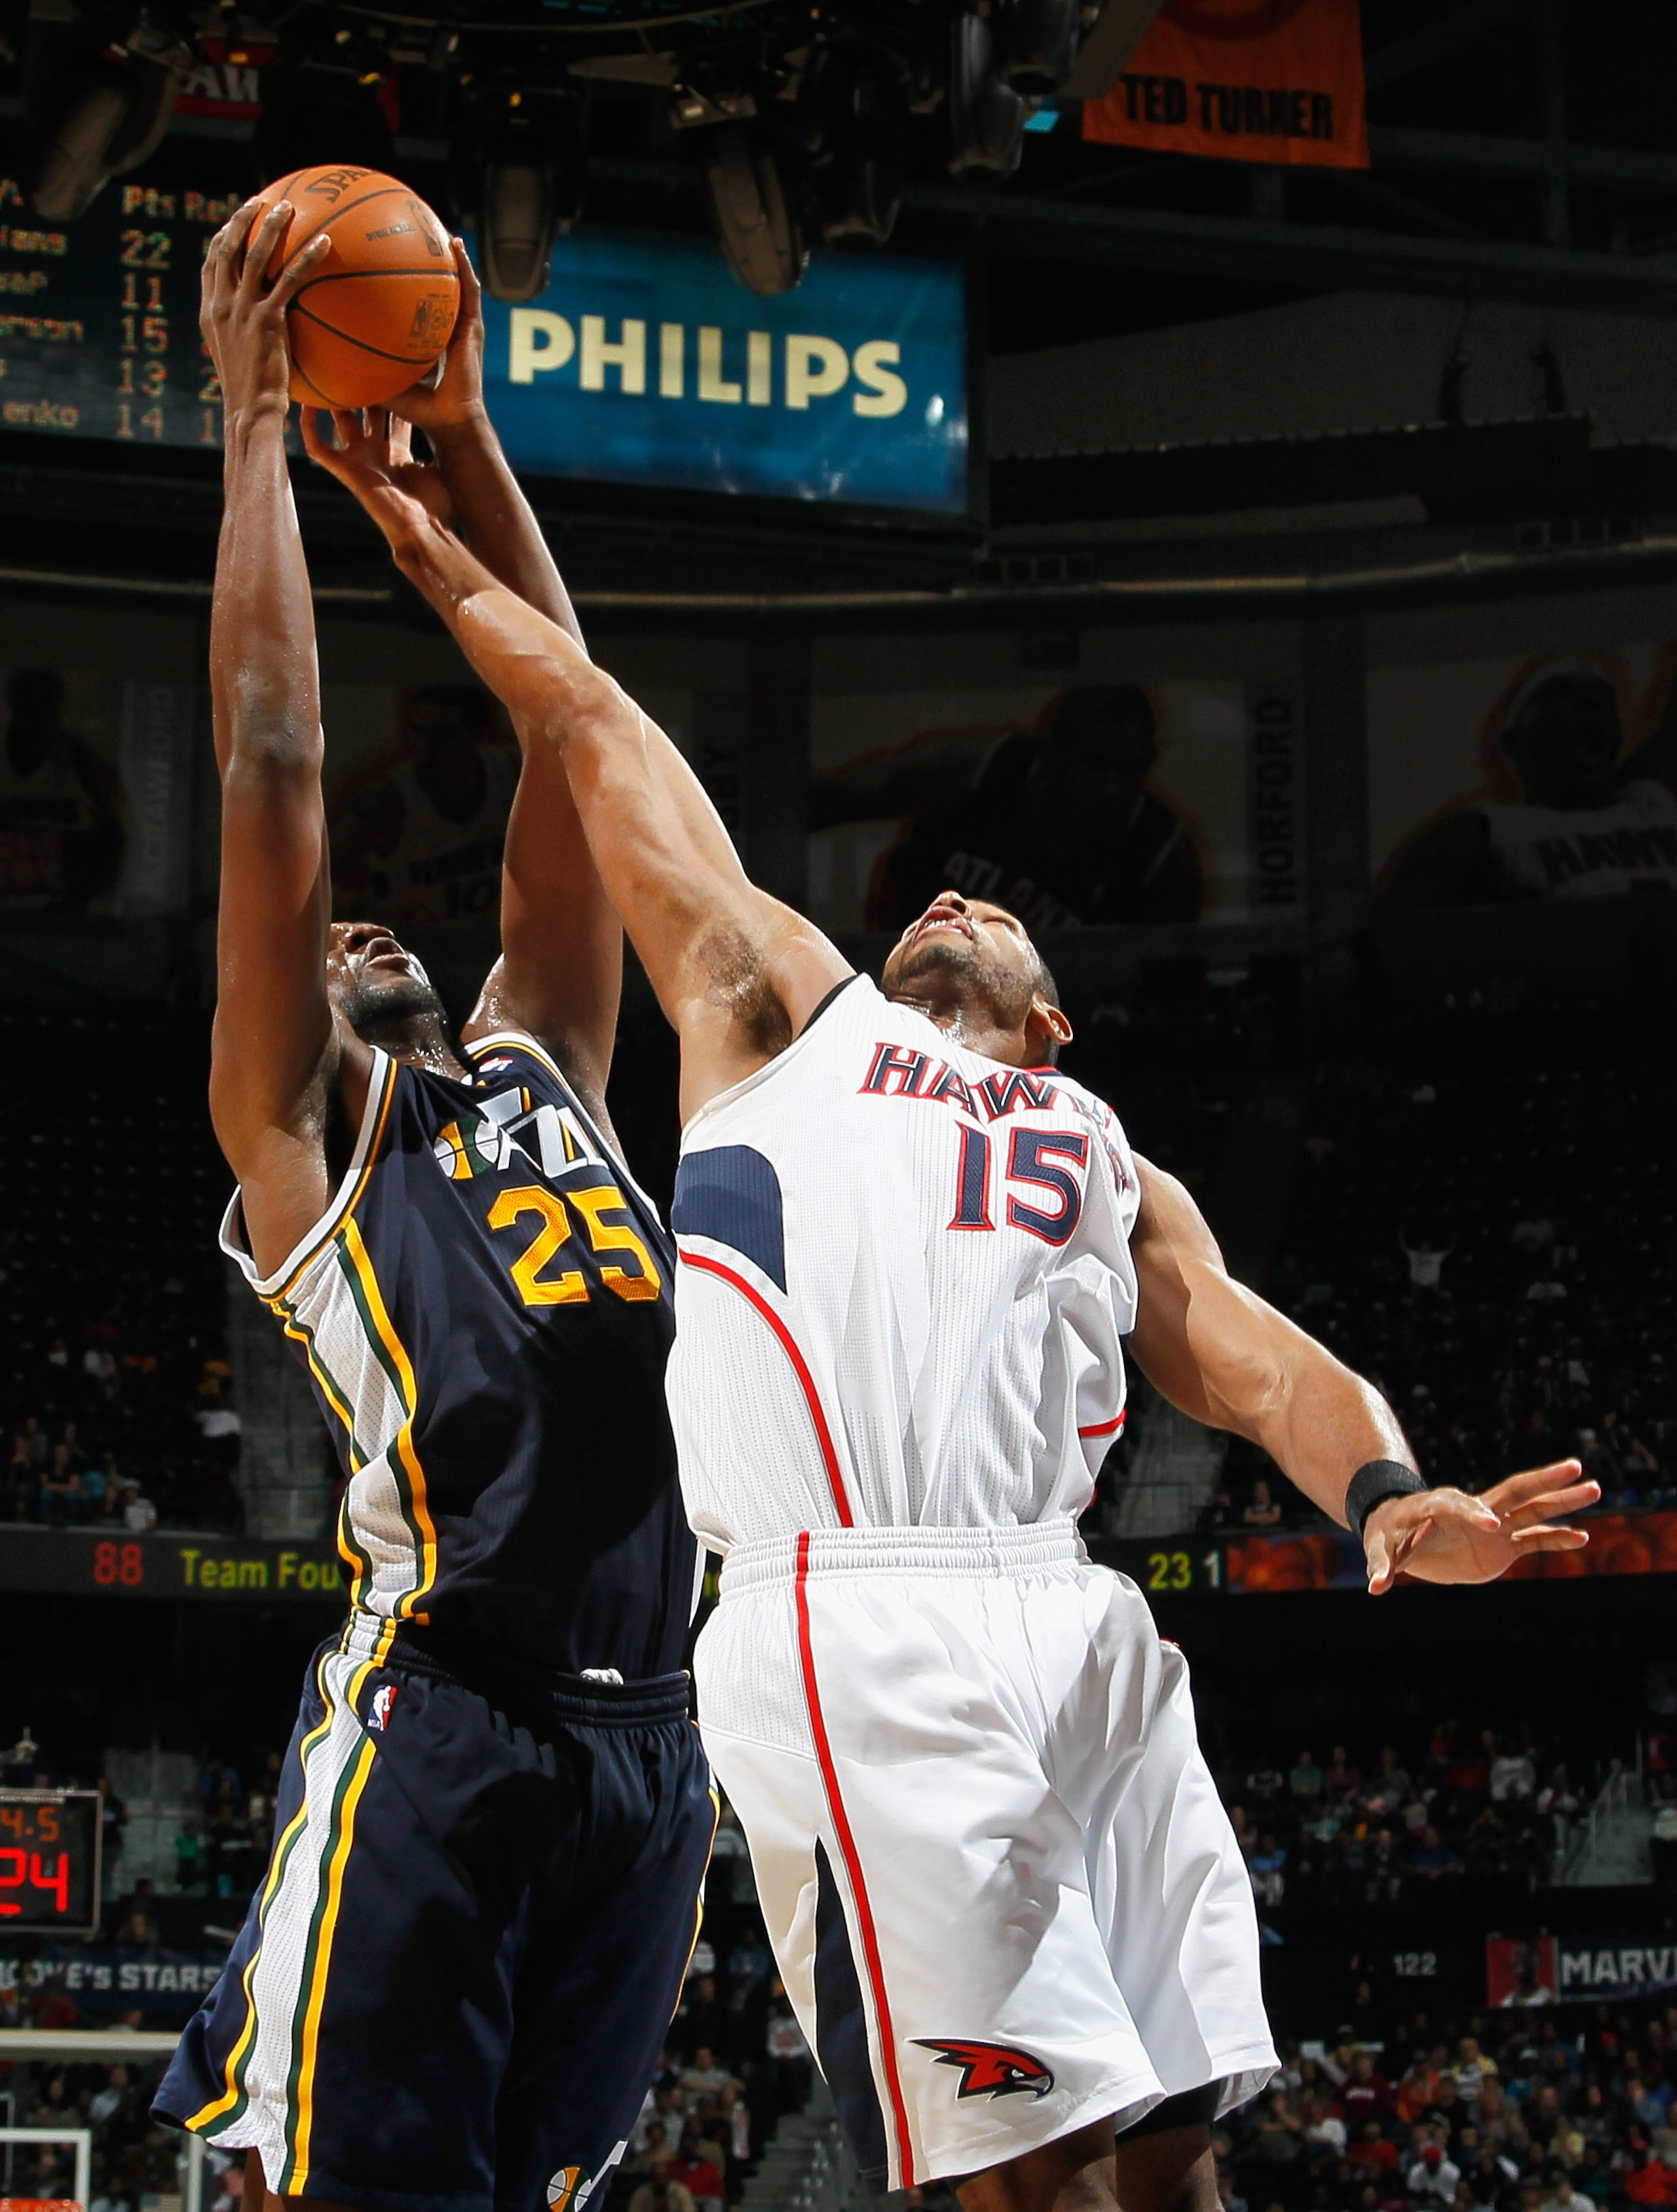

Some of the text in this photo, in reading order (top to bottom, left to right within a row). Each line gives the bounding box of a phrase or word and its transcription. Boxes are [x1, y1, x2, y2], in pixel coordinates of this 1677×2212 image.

[1118, 73, 1334, 141] TED TURNER
[121, 229, 171, 269] 22
[121, 273, 164, 312] 11
[121, 315, 168, 353] 15
[119, 357, 168, 398] 13
[508, 307, 909, 419] PHILIPS
[116, 402, 165, 438] 14
[1254, 696, 1296, 906] HORFORD
[946, 1119, 1089, 1247] 15
[487, 1185, 661, 1306] 25
[94, 1541, 143, 1586] 88
[179, 1548, 267, 1588] Team
[1148, 1550, 1220, 1590] 23 1
[0, 1847, 69, 1915] 24
[1394, 1952, 1437, 1975] 122
[1560, 1946, 1677, 1985] MARV
